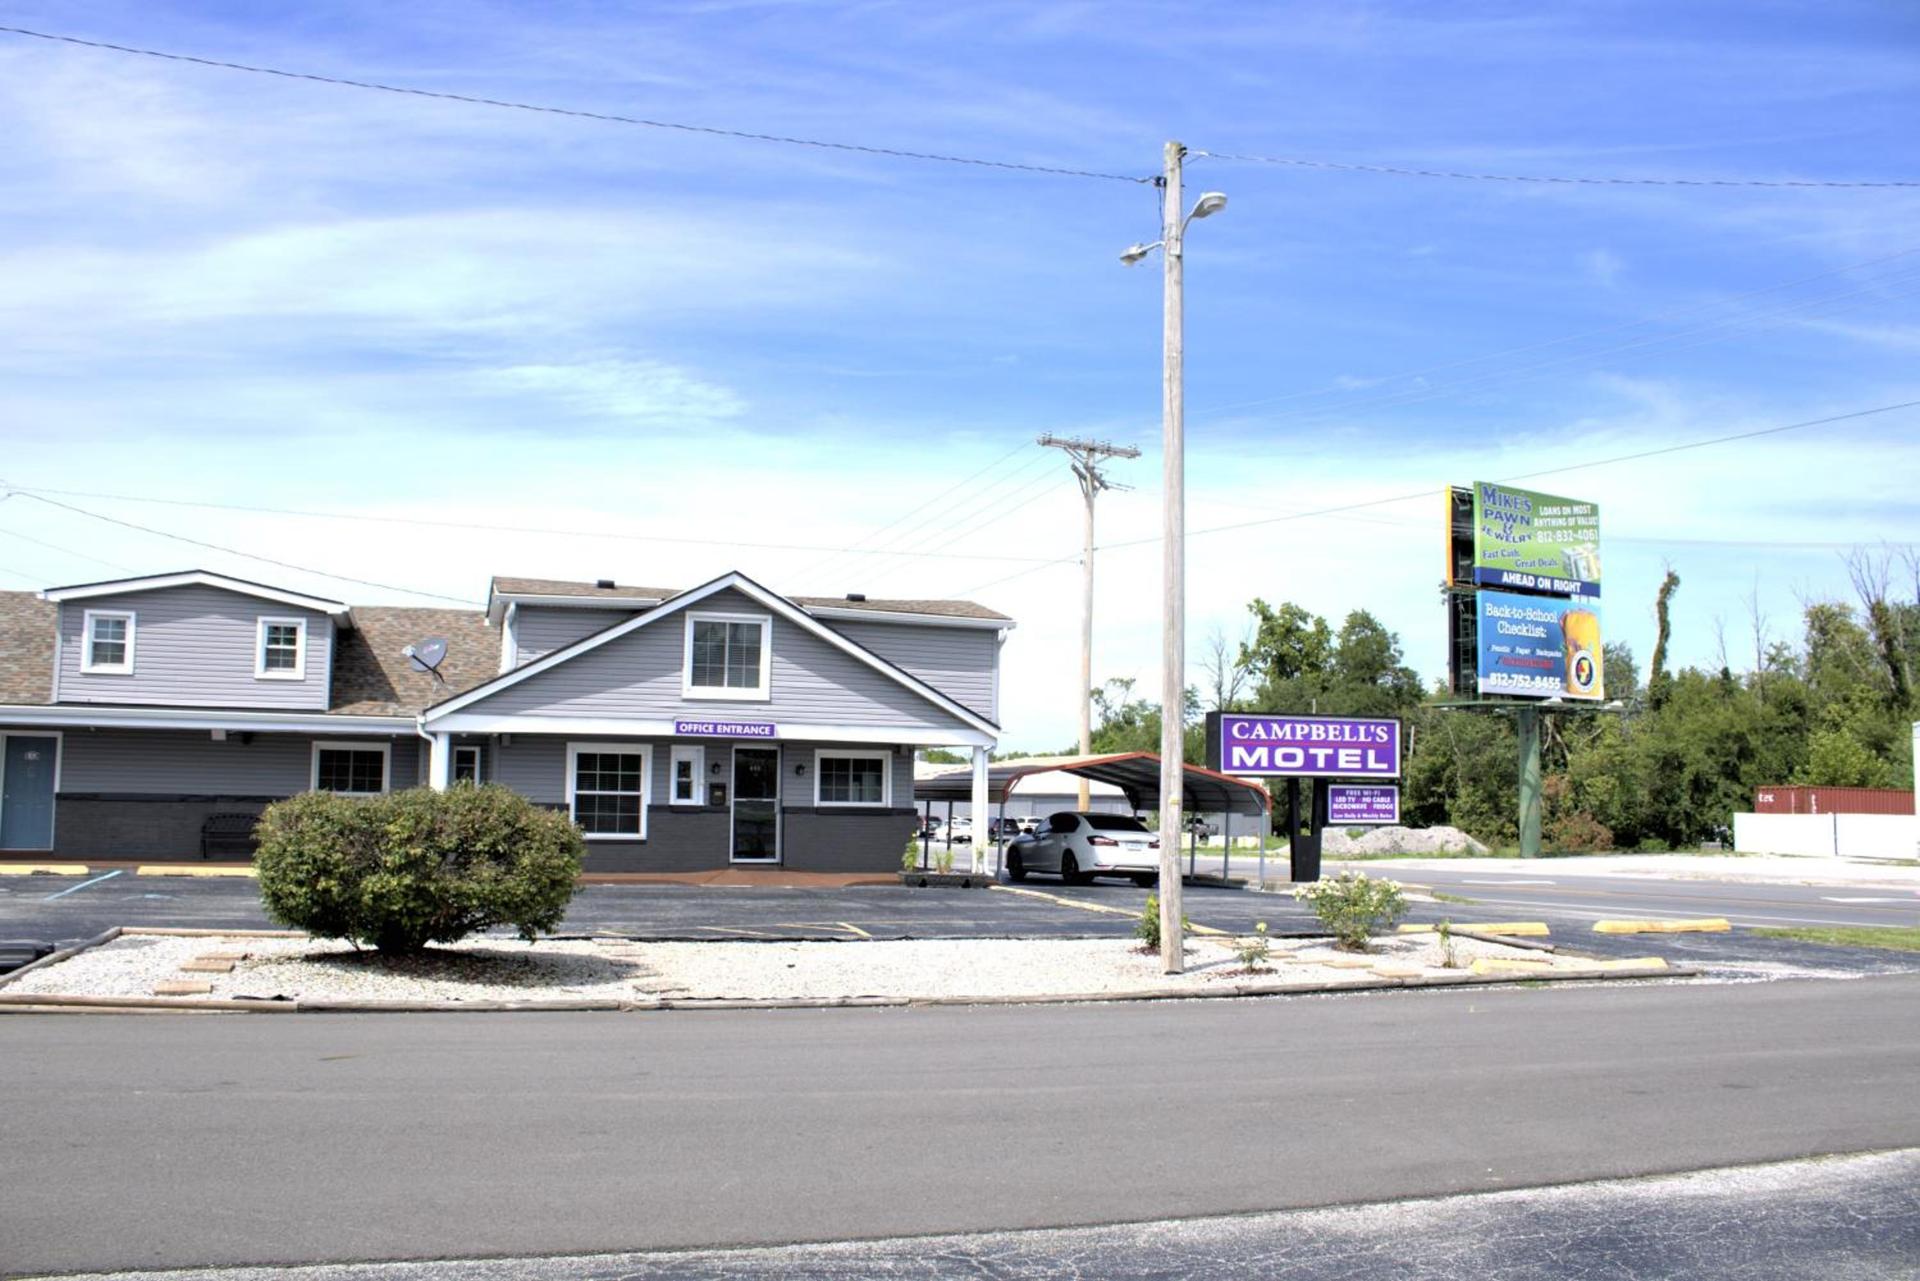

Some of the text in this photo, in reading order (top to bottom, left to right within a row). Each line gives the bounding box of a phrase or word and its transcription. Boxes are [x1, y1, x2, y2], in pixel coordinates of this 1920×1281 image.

[1484, 508, 1531, 526] PAWN
[1573, 504, 1592, 515] MOST
[1482, 525, 1532, 544] JEWELRY
[1515, 559, 1536, 569] Great
[1502, 571, 1582, 593] AHEAD ON RIGHT
[1485, 602, 1558, 623] Back-to-School
[1497, 620, 1547, 638] Checklist:
[680, 723, 771, 735] OFFICE ENTRANCE
[1231, 721, 1389, 743] CAMPBELL'S
[1232, 746, 1388, 770] MOTEL
